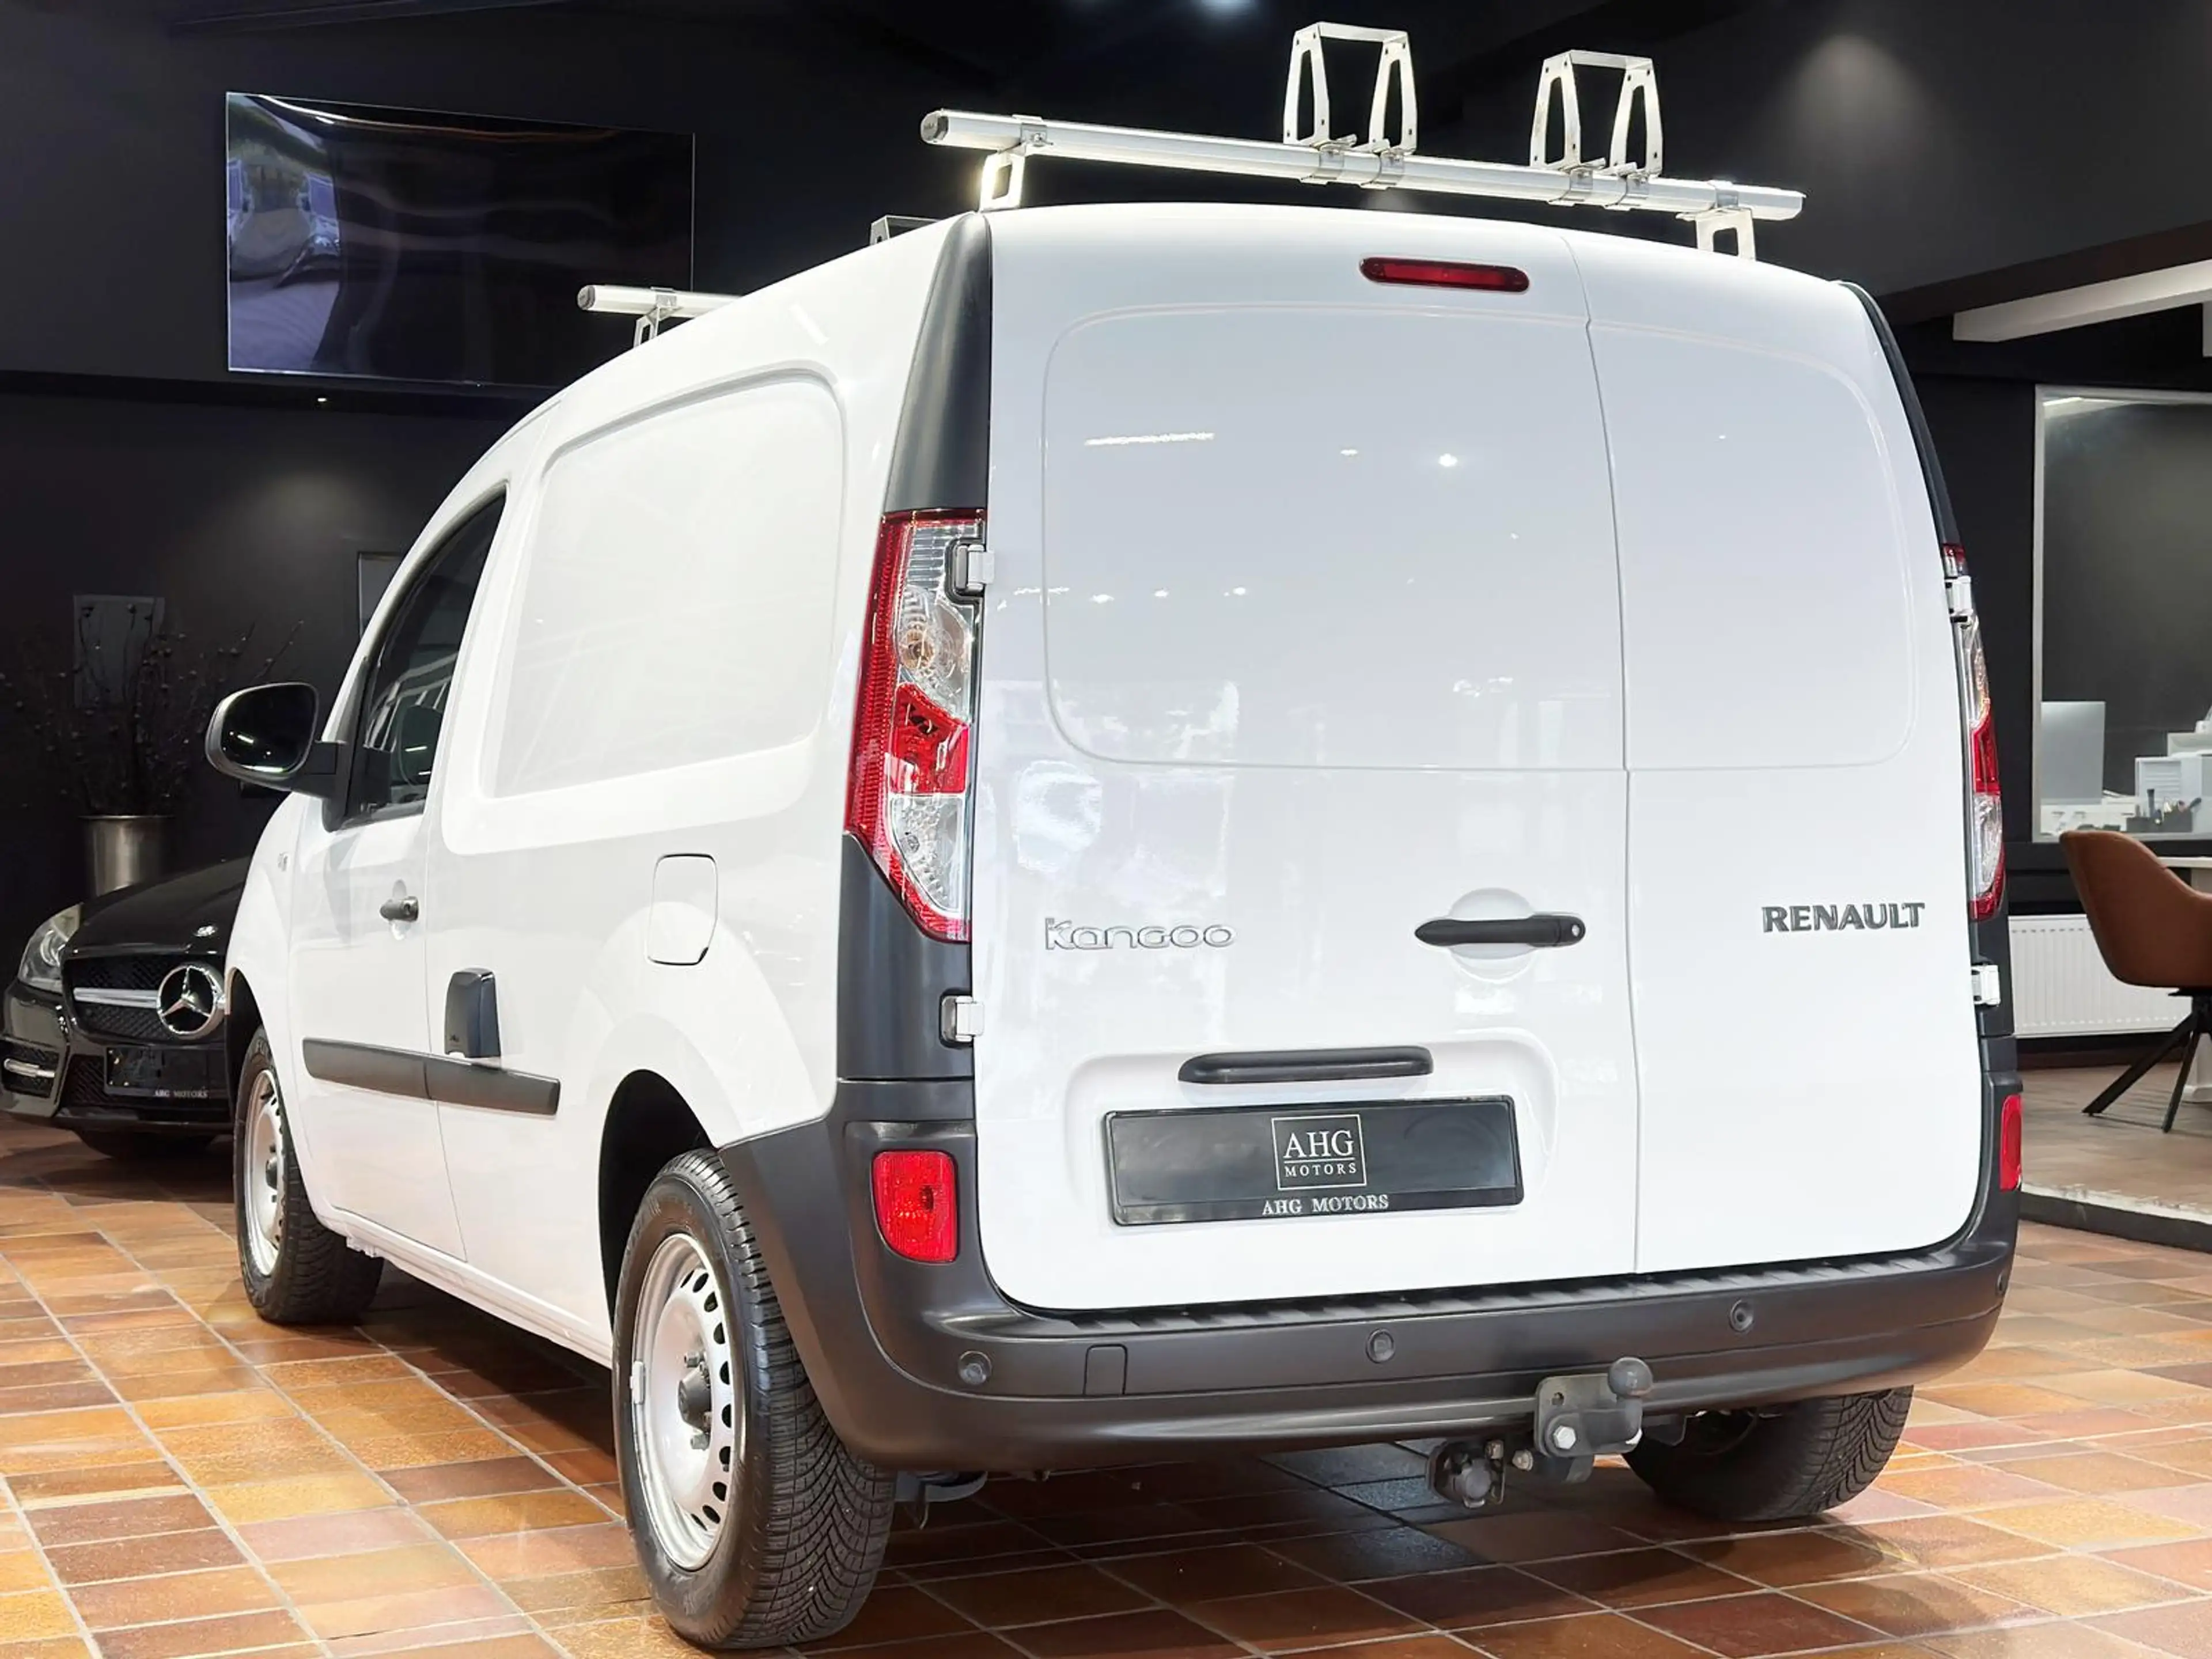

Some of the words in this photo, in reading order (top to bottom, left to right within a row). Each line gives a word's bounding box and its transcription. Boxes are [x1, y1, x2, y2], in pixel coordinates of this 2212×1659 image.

[1762, 902, 1925, 933] RENAULT
[1283, 1130, 1354, 1158] AHG
[1285, 1162, 1357, 1177] MOTORS
[1262, 1199, 1302, 1215] AHG
[1312, 1194, 1389, 1213] MOTORS
